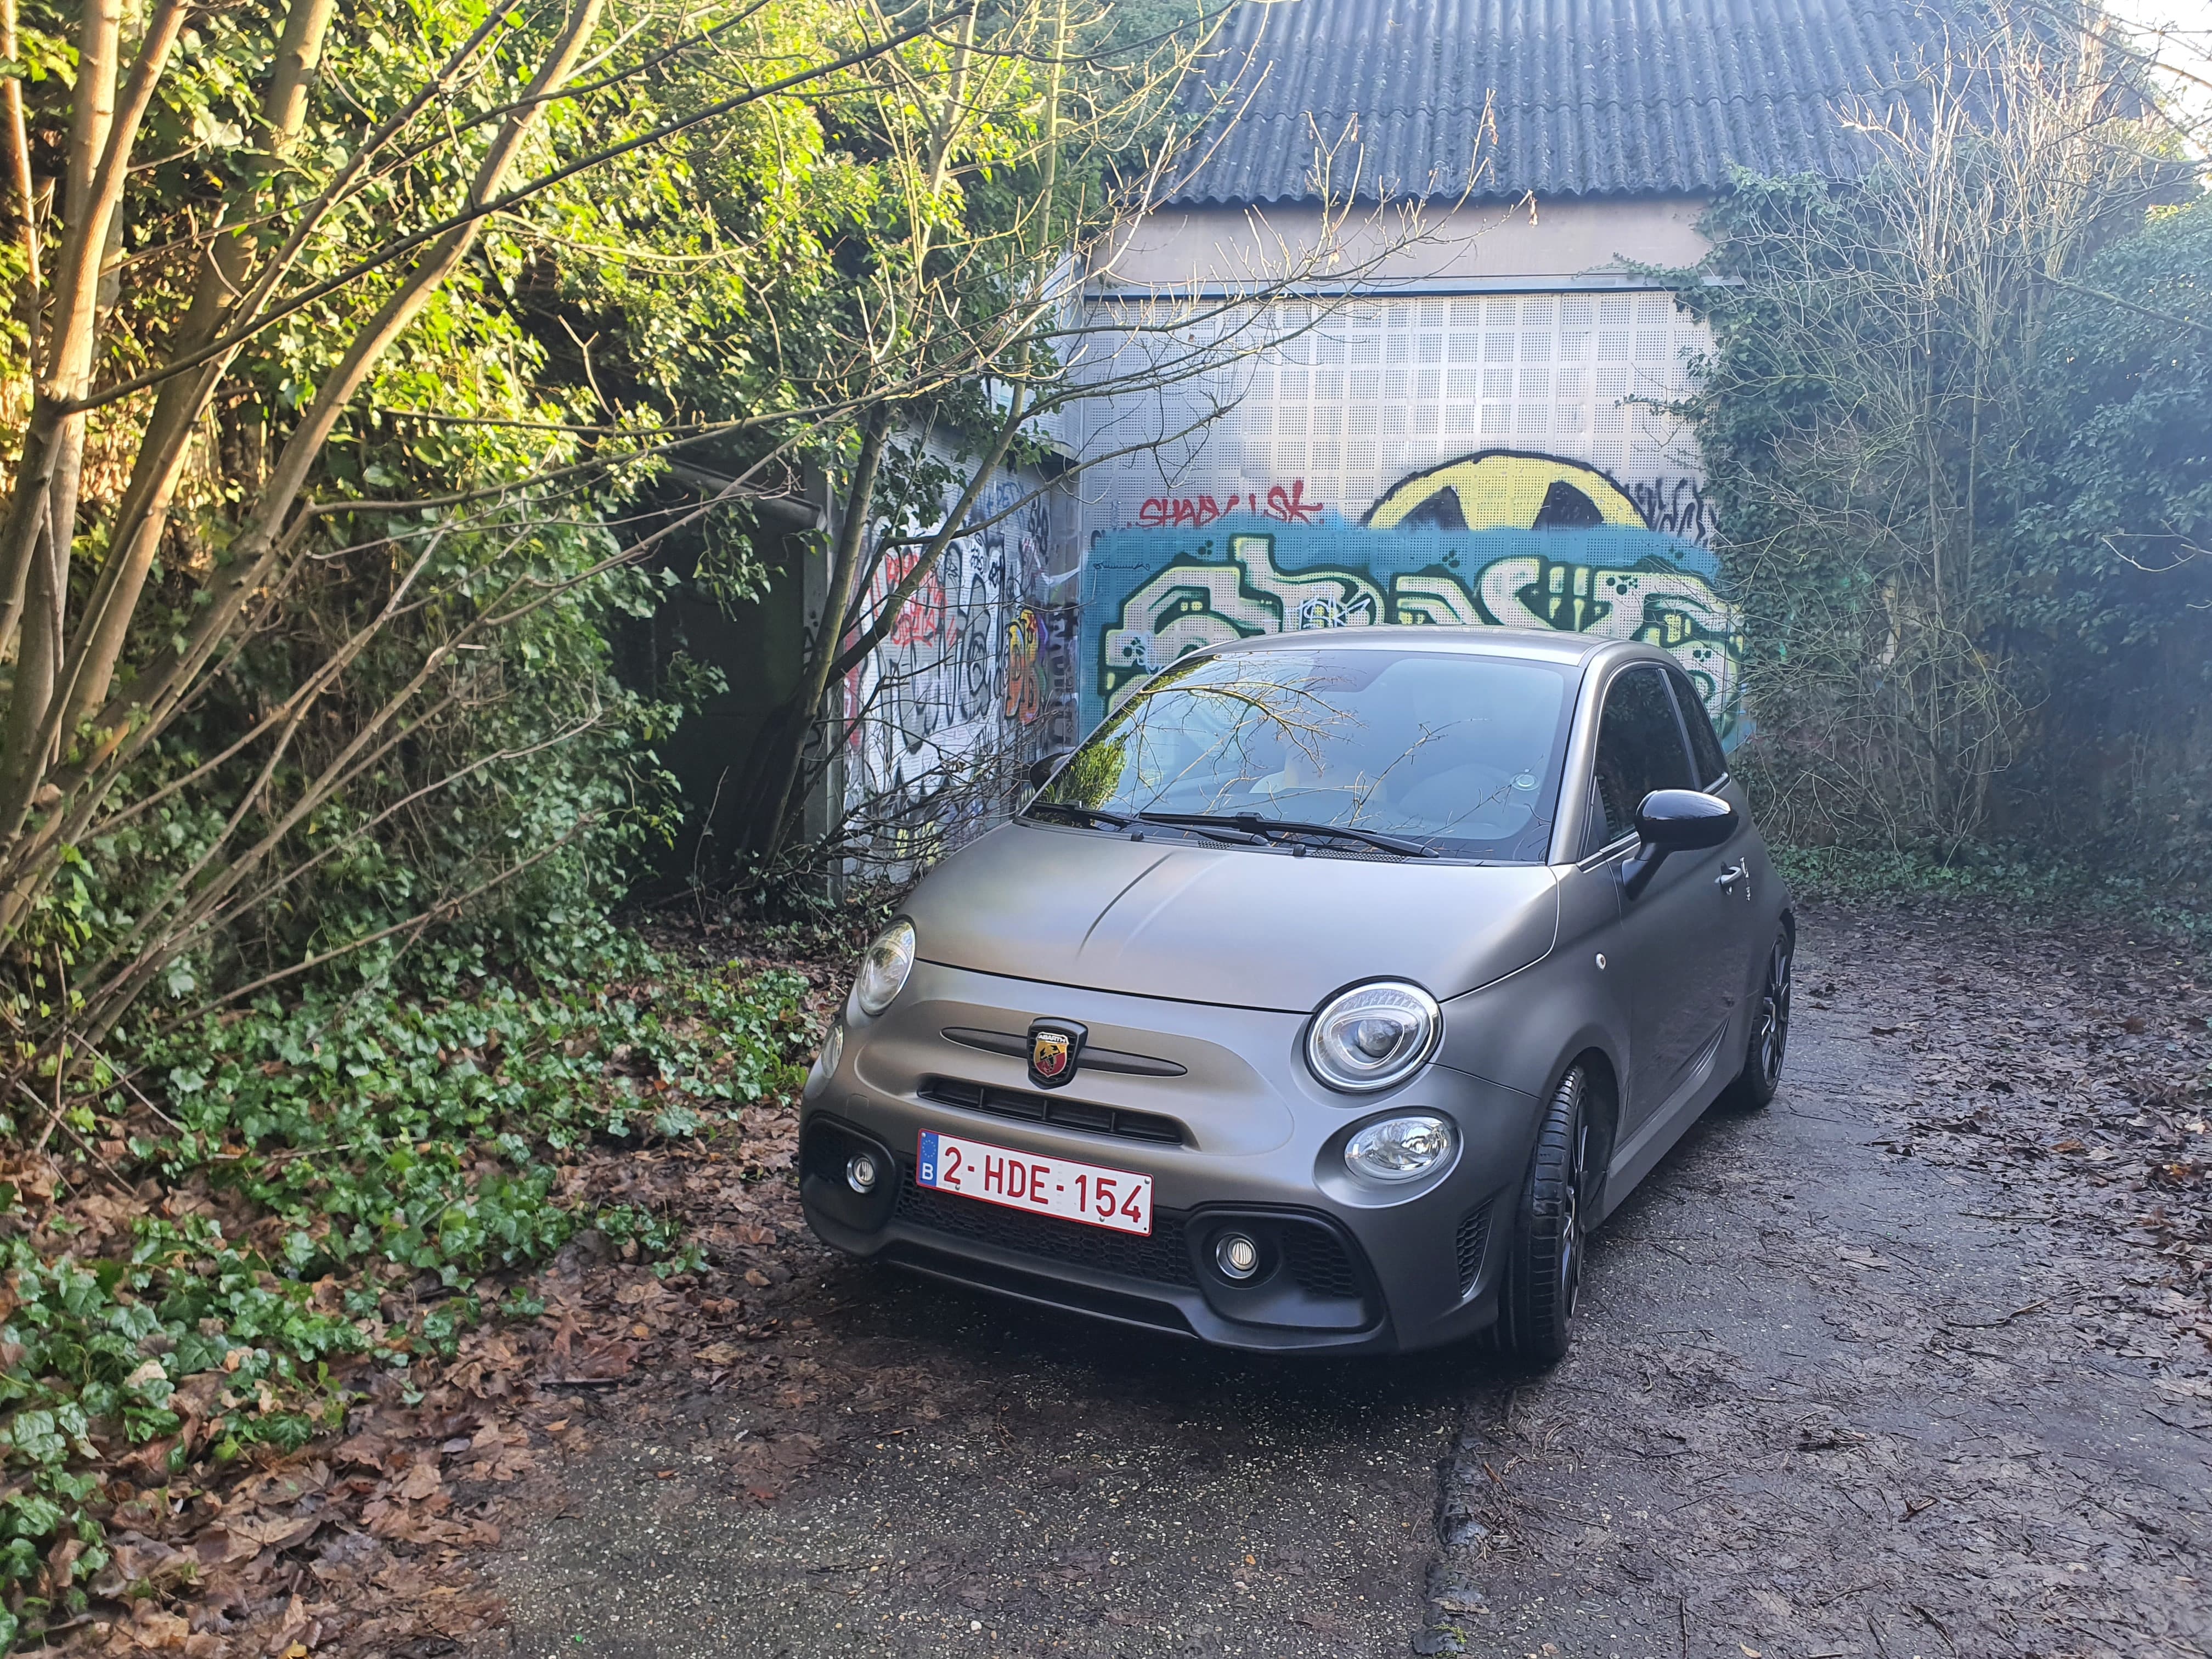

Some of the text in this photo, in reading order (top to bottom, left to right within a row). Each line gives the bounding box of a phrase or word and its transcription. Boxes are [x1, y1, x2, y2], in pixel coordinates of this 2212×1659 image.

[1038, 1034, 1065, 1043] ABARTH
[922, 1162, 934, 1181] B
[943, 1146, 1142, 1223] 2-HDE-154
